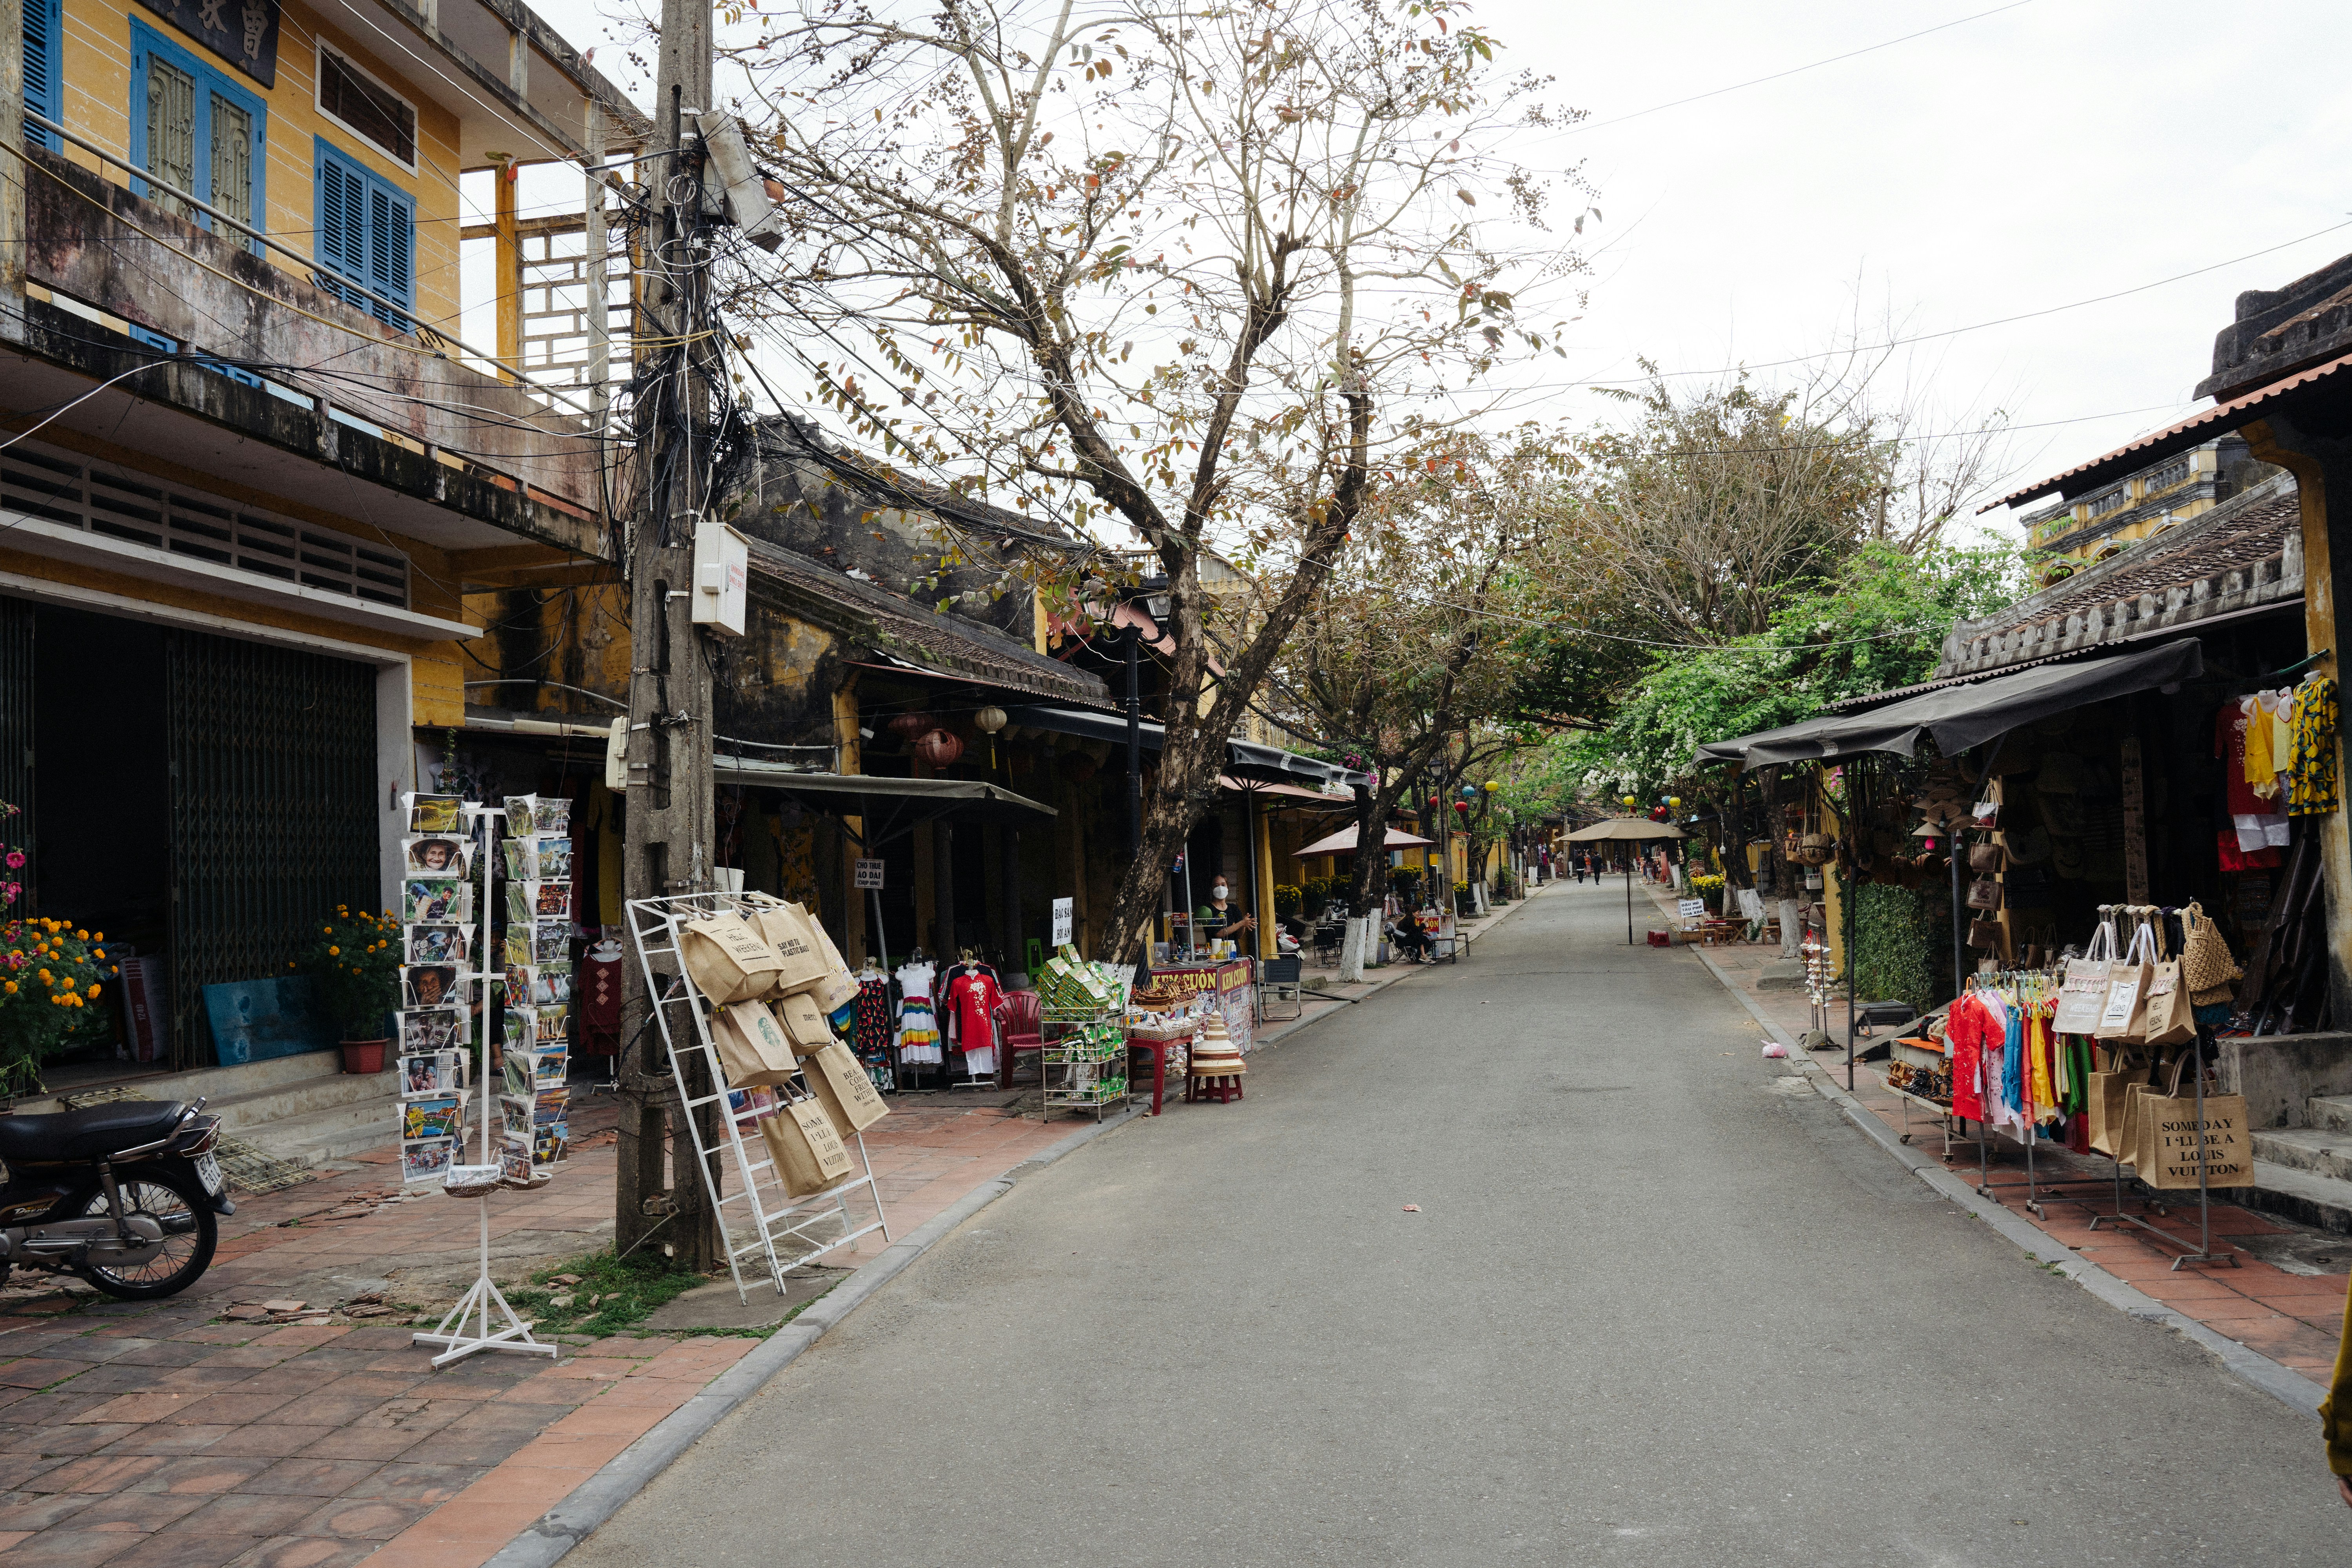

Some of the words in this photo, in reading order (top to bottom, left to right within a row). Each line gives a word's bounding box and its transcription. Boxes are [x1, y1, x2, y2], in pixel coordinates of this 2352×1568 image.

[857, 869, 867, 878] ÁO
[869, 870, 881, 879] DÀI
[1064, 927, 1070, 938] AN
[731, 942, 764, 954] WEEKEND
[777, 942, 788, 950] SAY
[781, 947, 800, 958] PLASTIC
[800, 945, 809, 954] BAGS
[1222, 971, 1233, 991] KEM
[1234, 963, 1247, 987] CUỘN
[803, 1013, 817, 1021] merci
[855, 1080, 870, 1093] FROM
[2162, 1118, 2233, 1132] SOMEDAY
[2165, 1137, 2171, 1146] I
[2225, 1134, 2235, 1143] A
[823, 1152, 845, 1167] VUITTON
[2180, 1149, 2225, 1161] LOUIS
